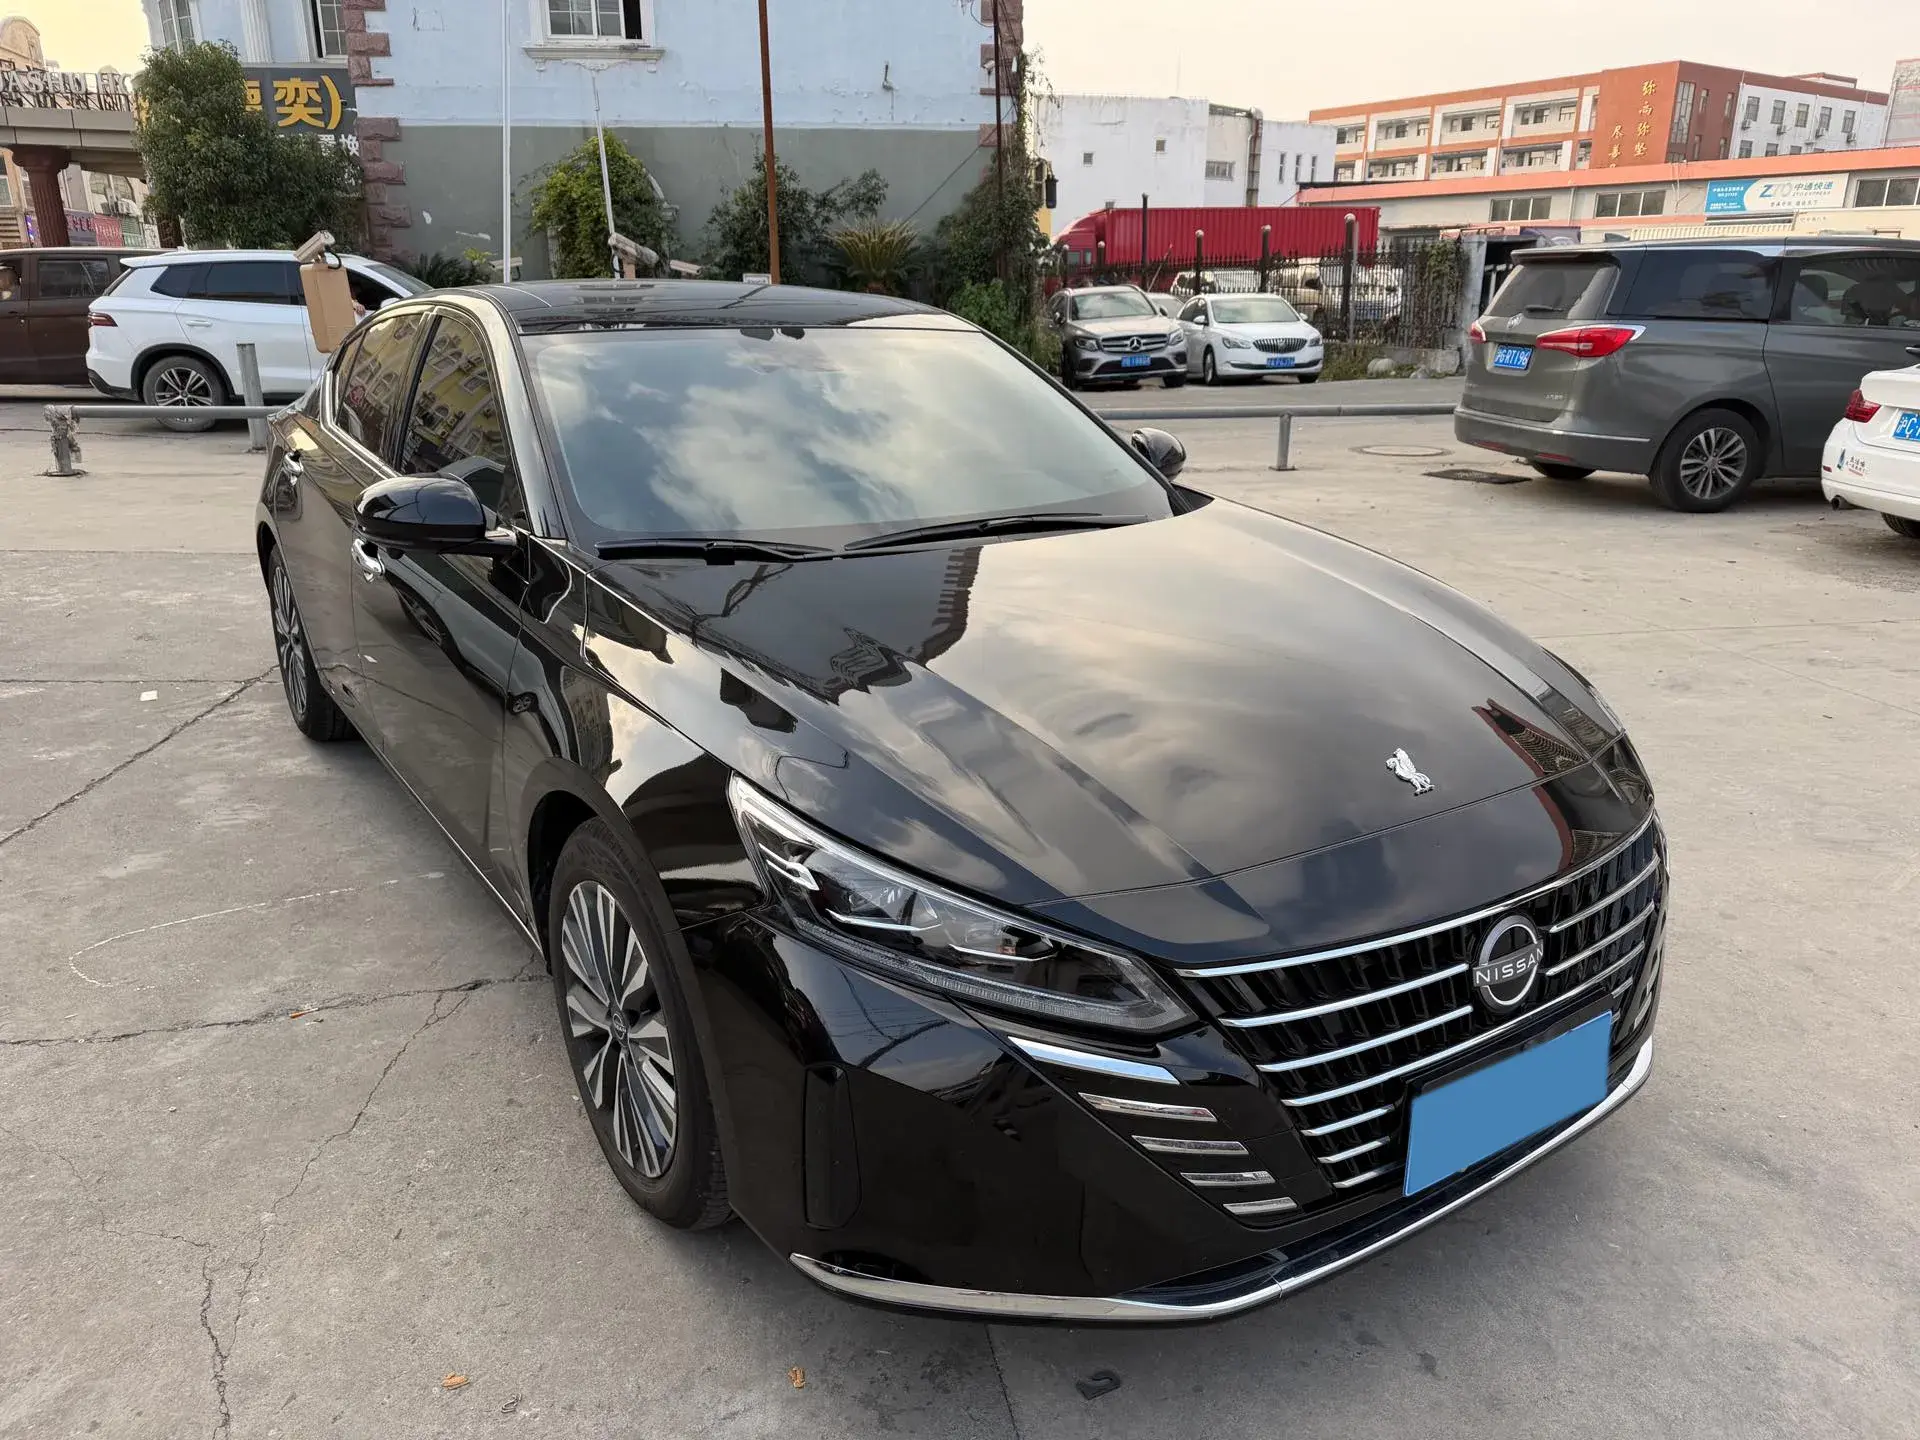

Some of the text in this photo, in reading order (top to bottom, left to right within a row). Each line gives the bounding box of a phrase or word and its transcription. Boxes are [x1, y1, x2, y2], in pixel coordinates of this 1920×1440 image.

[1794, 181, 1833, 191] 中通快递
[1475, 943, 1544, 984] NISSAN
